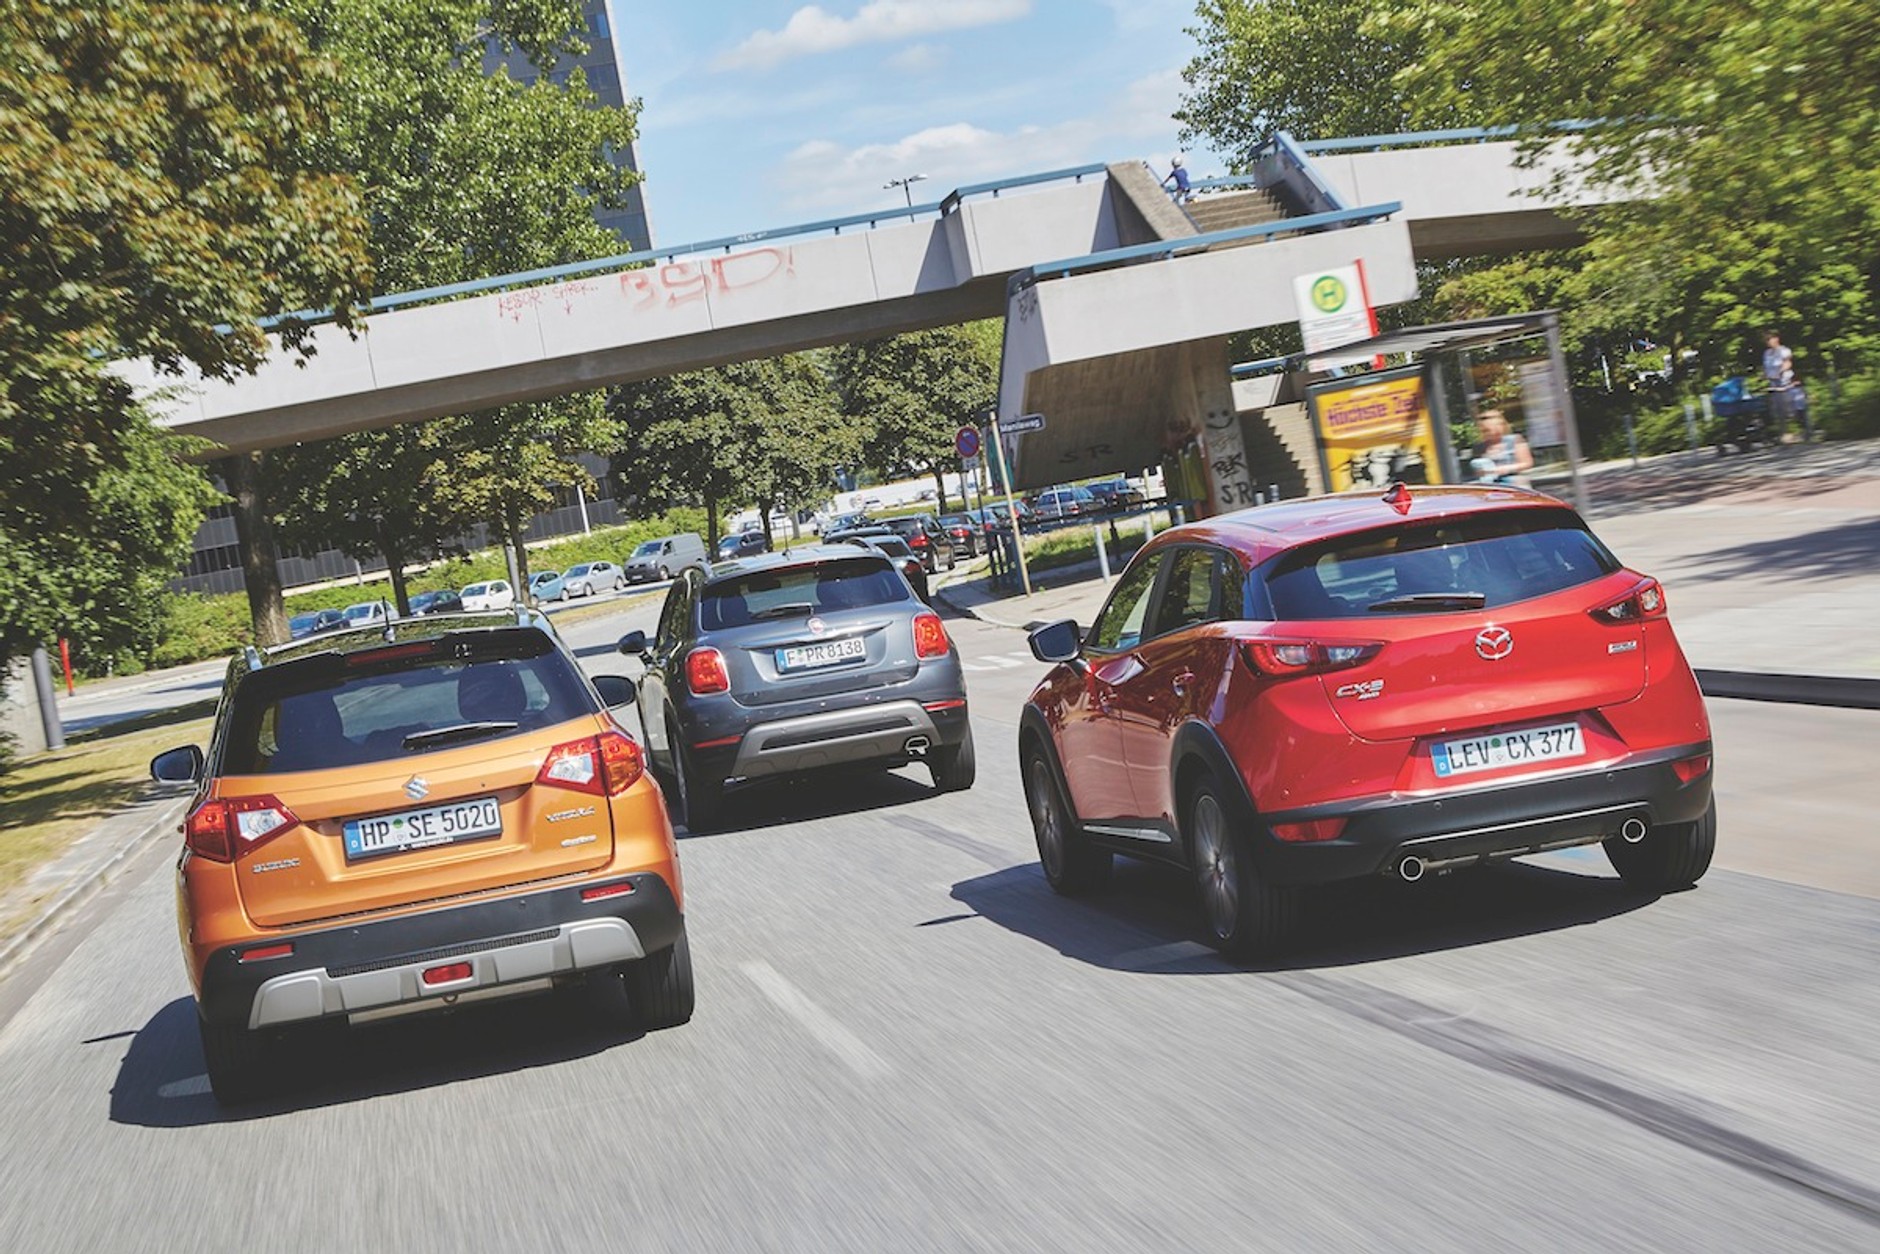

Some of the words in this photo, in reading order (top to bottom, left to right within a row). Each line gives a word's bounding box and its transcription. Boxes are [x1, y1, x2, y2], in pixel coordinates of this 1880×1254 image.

[805, 646, 825, 661] PR
[827, 639, 863, 658] 8138
[1447, 740, 1490, 770] LEV
[1505, 734, 1535, 760] CX
[1538, 727, 1576, 755] 377
[361, 821, 390, 847] HP
[407, 813, 437, 839] SE
[440, 802, 497, 833] 5020
